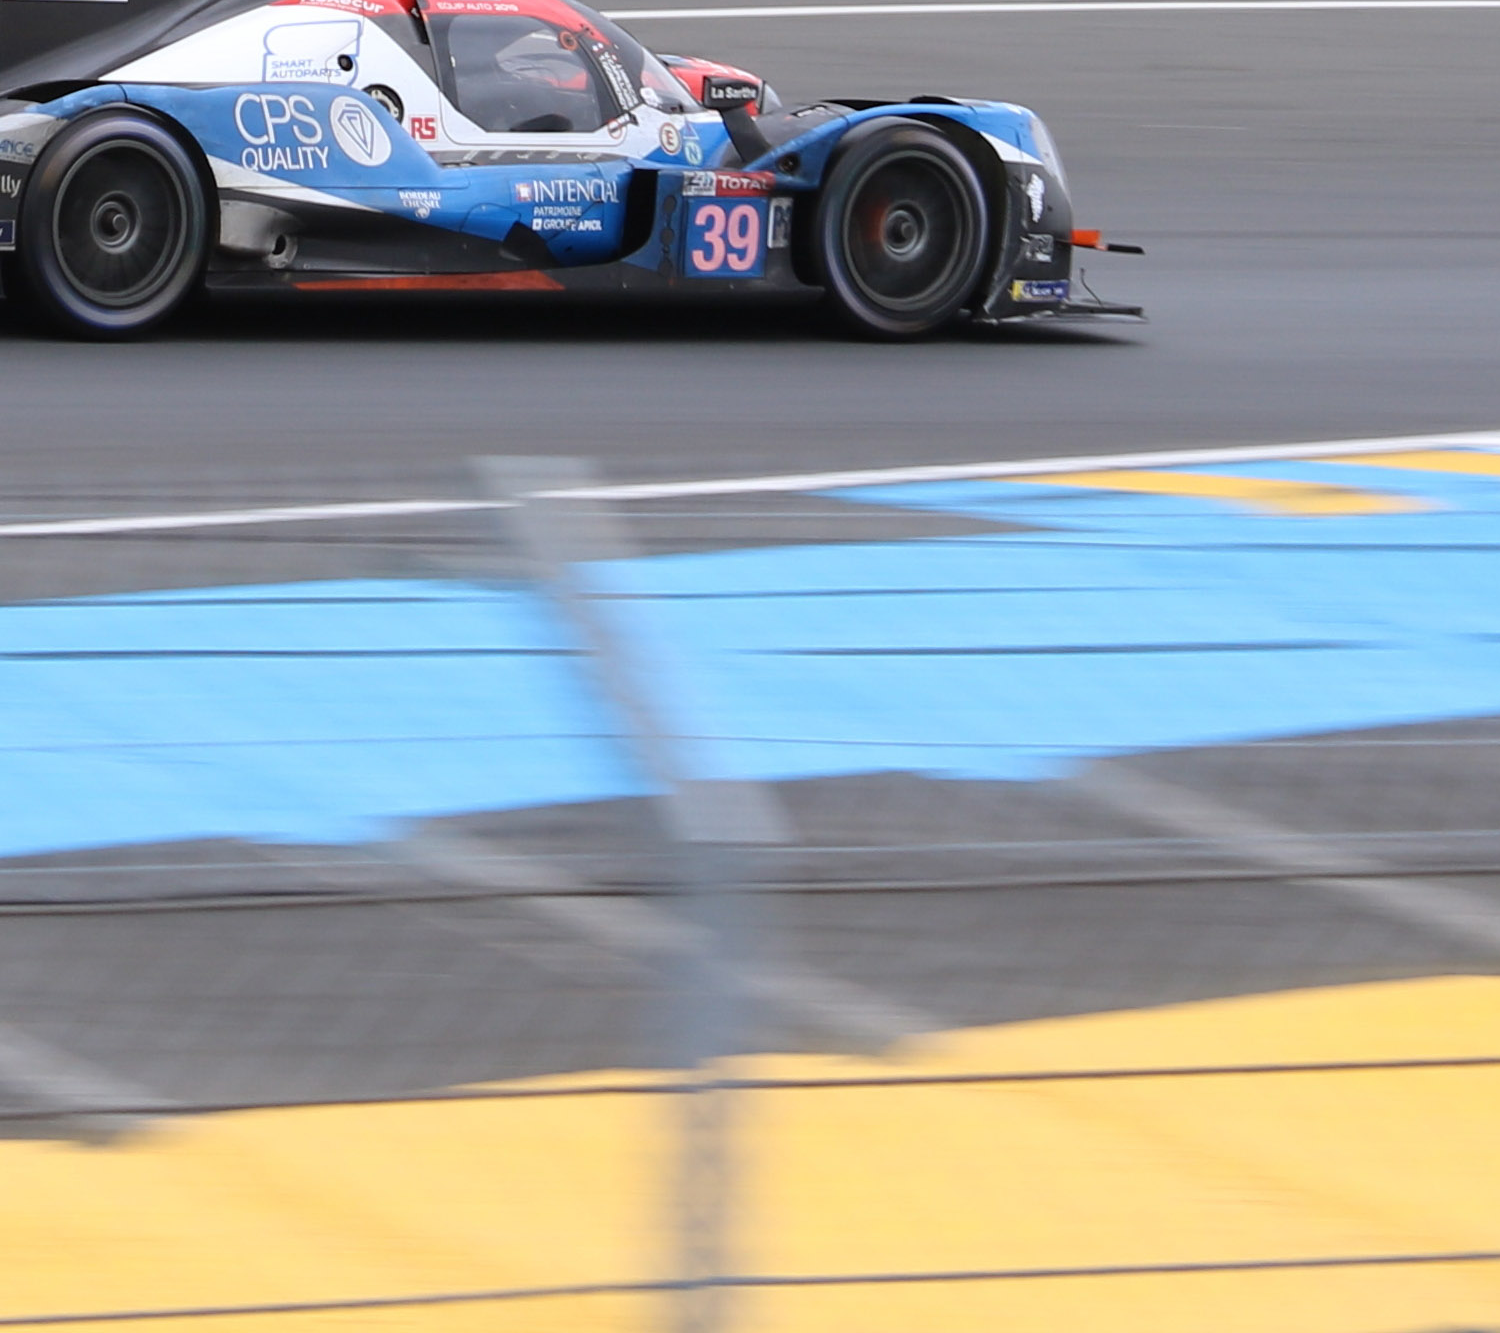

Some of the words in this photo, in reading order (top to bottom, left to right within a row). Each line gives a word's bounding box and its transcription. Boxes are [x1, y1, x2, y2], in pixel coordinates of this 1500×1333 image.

[270, 68, 342, 79] AUTOPARTS
[271, 59, 312, 69] SMART
[711, 87, 724, 99] La
[234, 92, 323, 145] CPS
[410, 117, 436, 140] RS
[242, 145, 329, 172] QUALITY
[533, 179, 620, 203] INTENCIAL
[717, 175, 769, 190] TOTAL
[692, 203, 759, 272] 39
